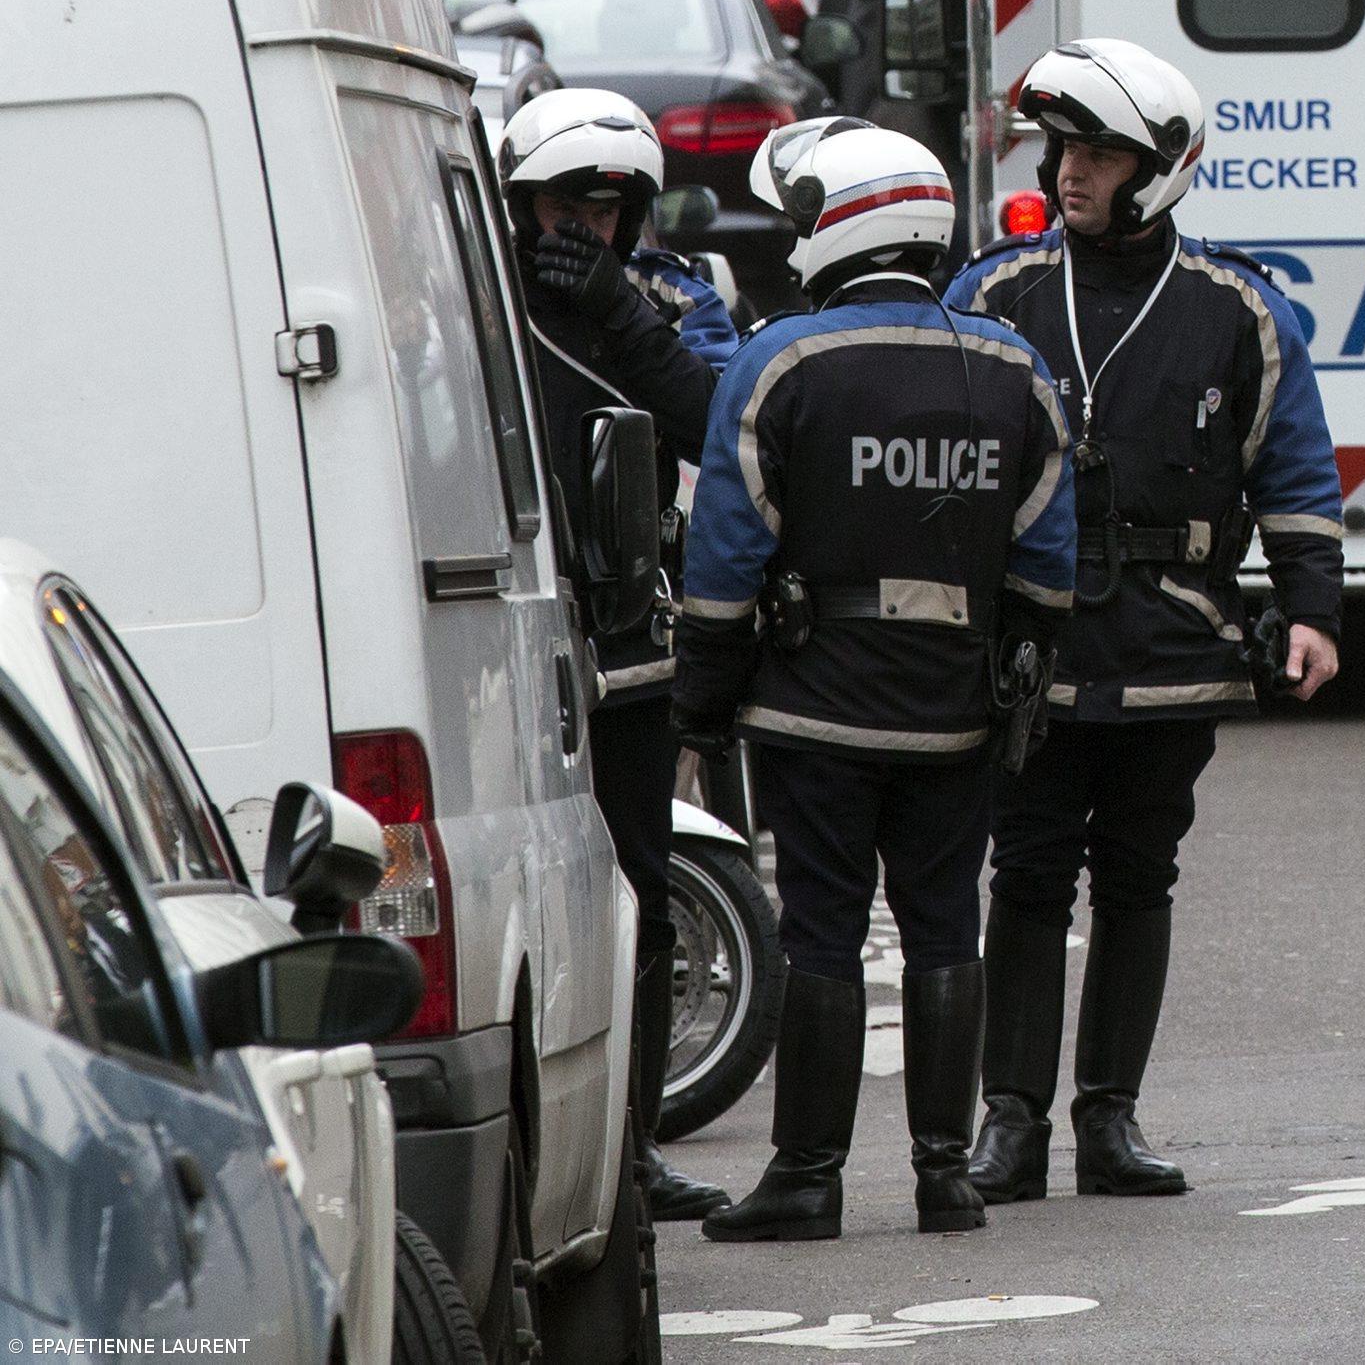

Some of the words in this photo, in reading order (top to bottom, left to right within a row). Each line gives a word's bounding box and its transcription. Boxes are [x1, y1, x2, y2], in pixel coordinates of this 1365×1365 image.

[1215, 99, 1331, 132] SMUR
[1193, 158, 1358, 190] NECKER
[852, 436, 1000, 490] POLICE
